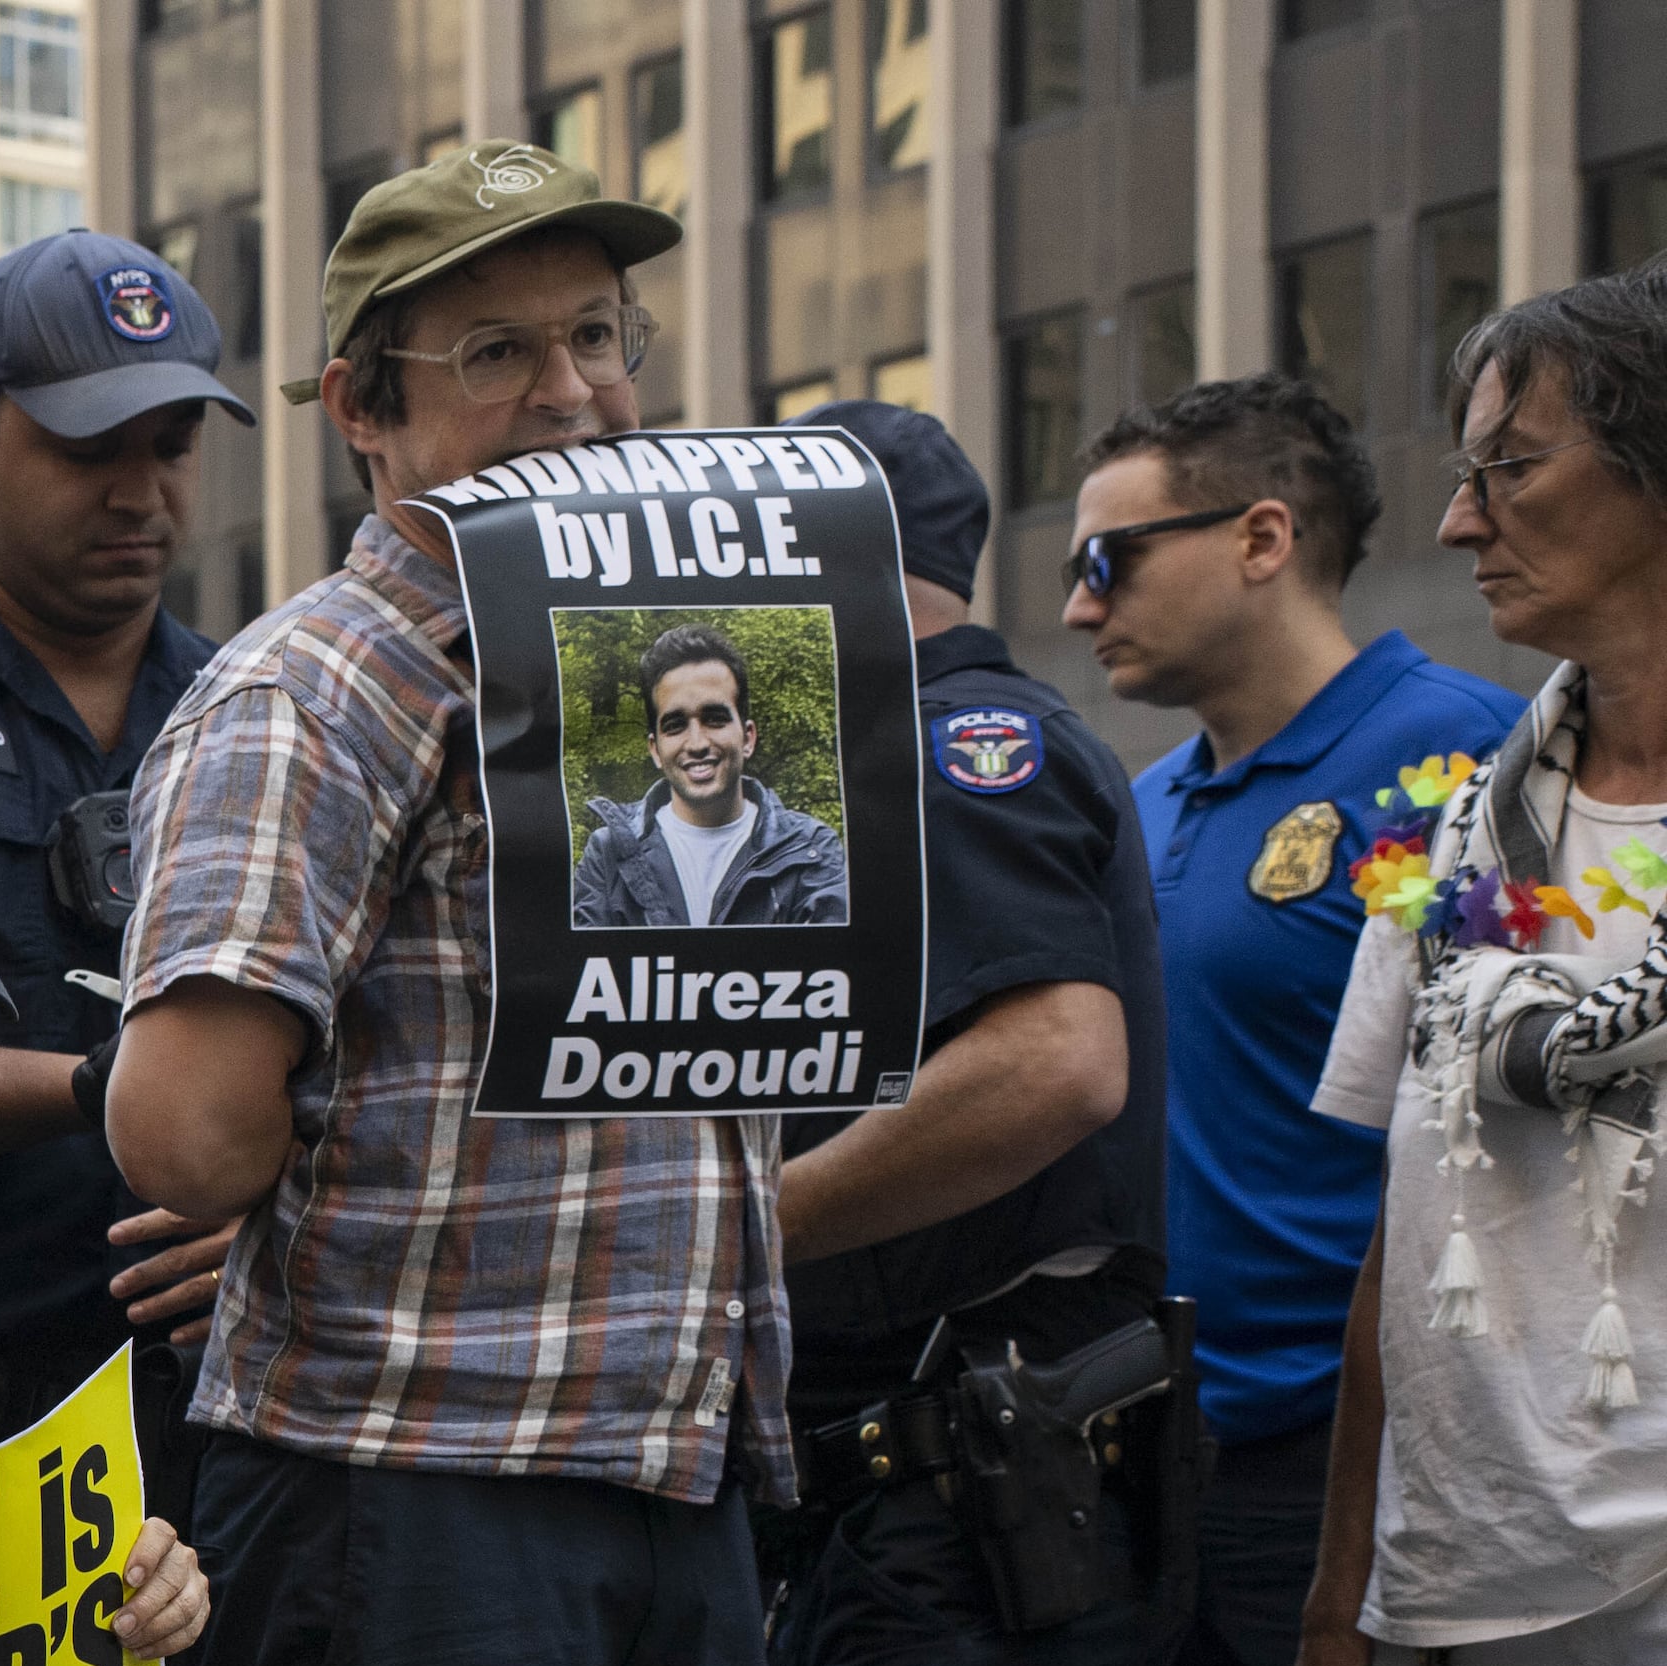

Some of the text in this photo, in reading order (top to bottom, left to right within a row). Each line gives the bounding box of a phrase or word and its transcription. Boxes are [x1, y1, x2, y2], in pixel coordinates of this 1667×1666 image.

[425, 436, 867, 506] KIDNAPPED
[532, 496, 822, 586] by I.C.E.
[948, 711, 1028, 733] POLICE
[566, 956, 851, 1023] Alireza
[541, 1030, 864, 1100] Doroudi
[38, 1443, 115, 1601] is
